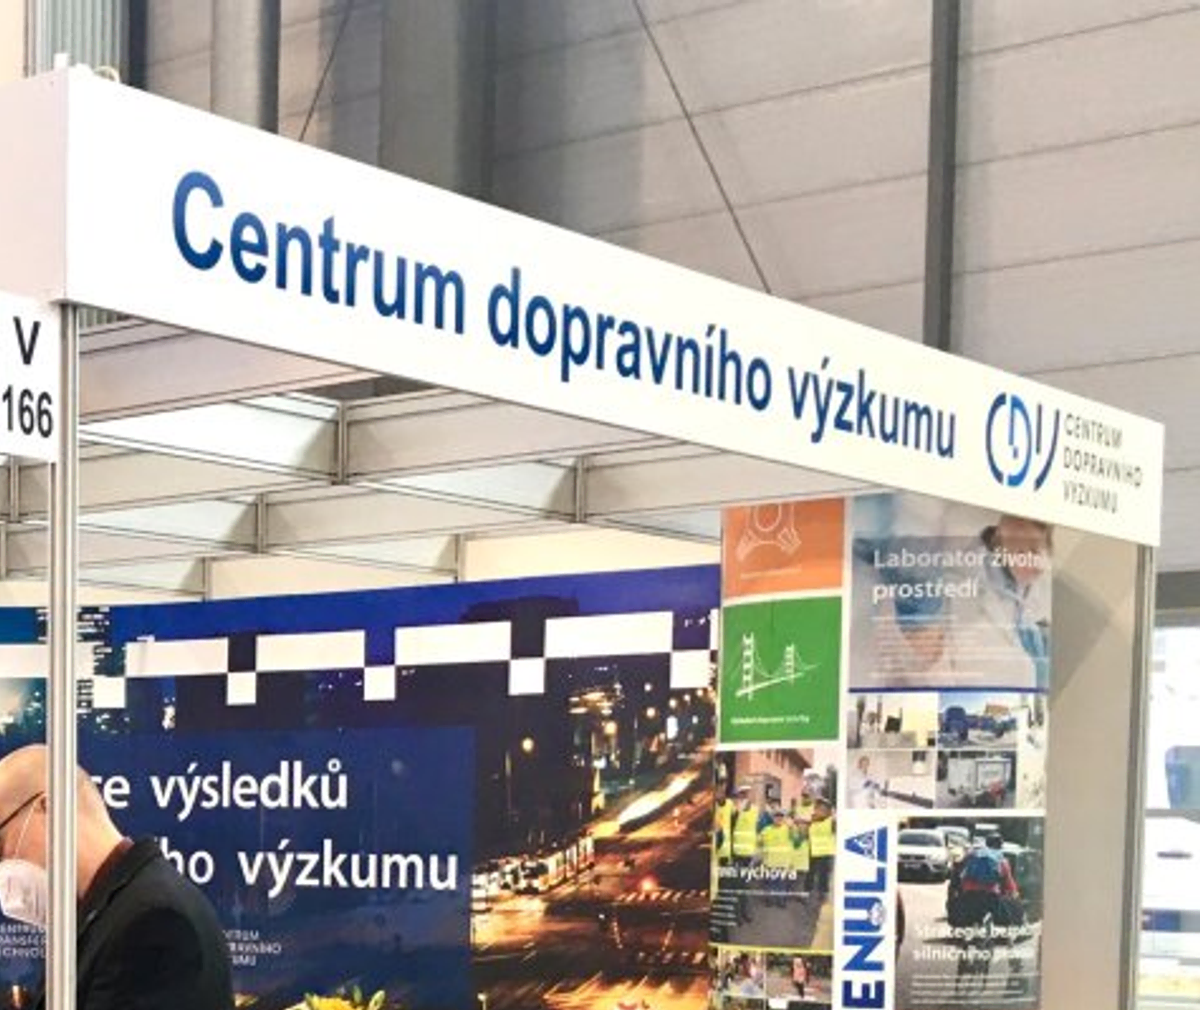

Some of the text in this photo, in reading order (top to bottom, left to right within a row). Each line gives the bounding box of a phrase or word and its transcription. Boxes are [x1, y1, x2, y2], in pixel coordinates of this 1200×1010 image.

[13, 317, 40, 365] V
[172, 171, 957, 459] Centrum dopravního výzkumu
[2, 386, 53, 439] 166
[1064, 413, 1122, 448] CENTRUM
[150, 758, 348, 822] výsledků
[237, 838, 458, 899] výzkumu
